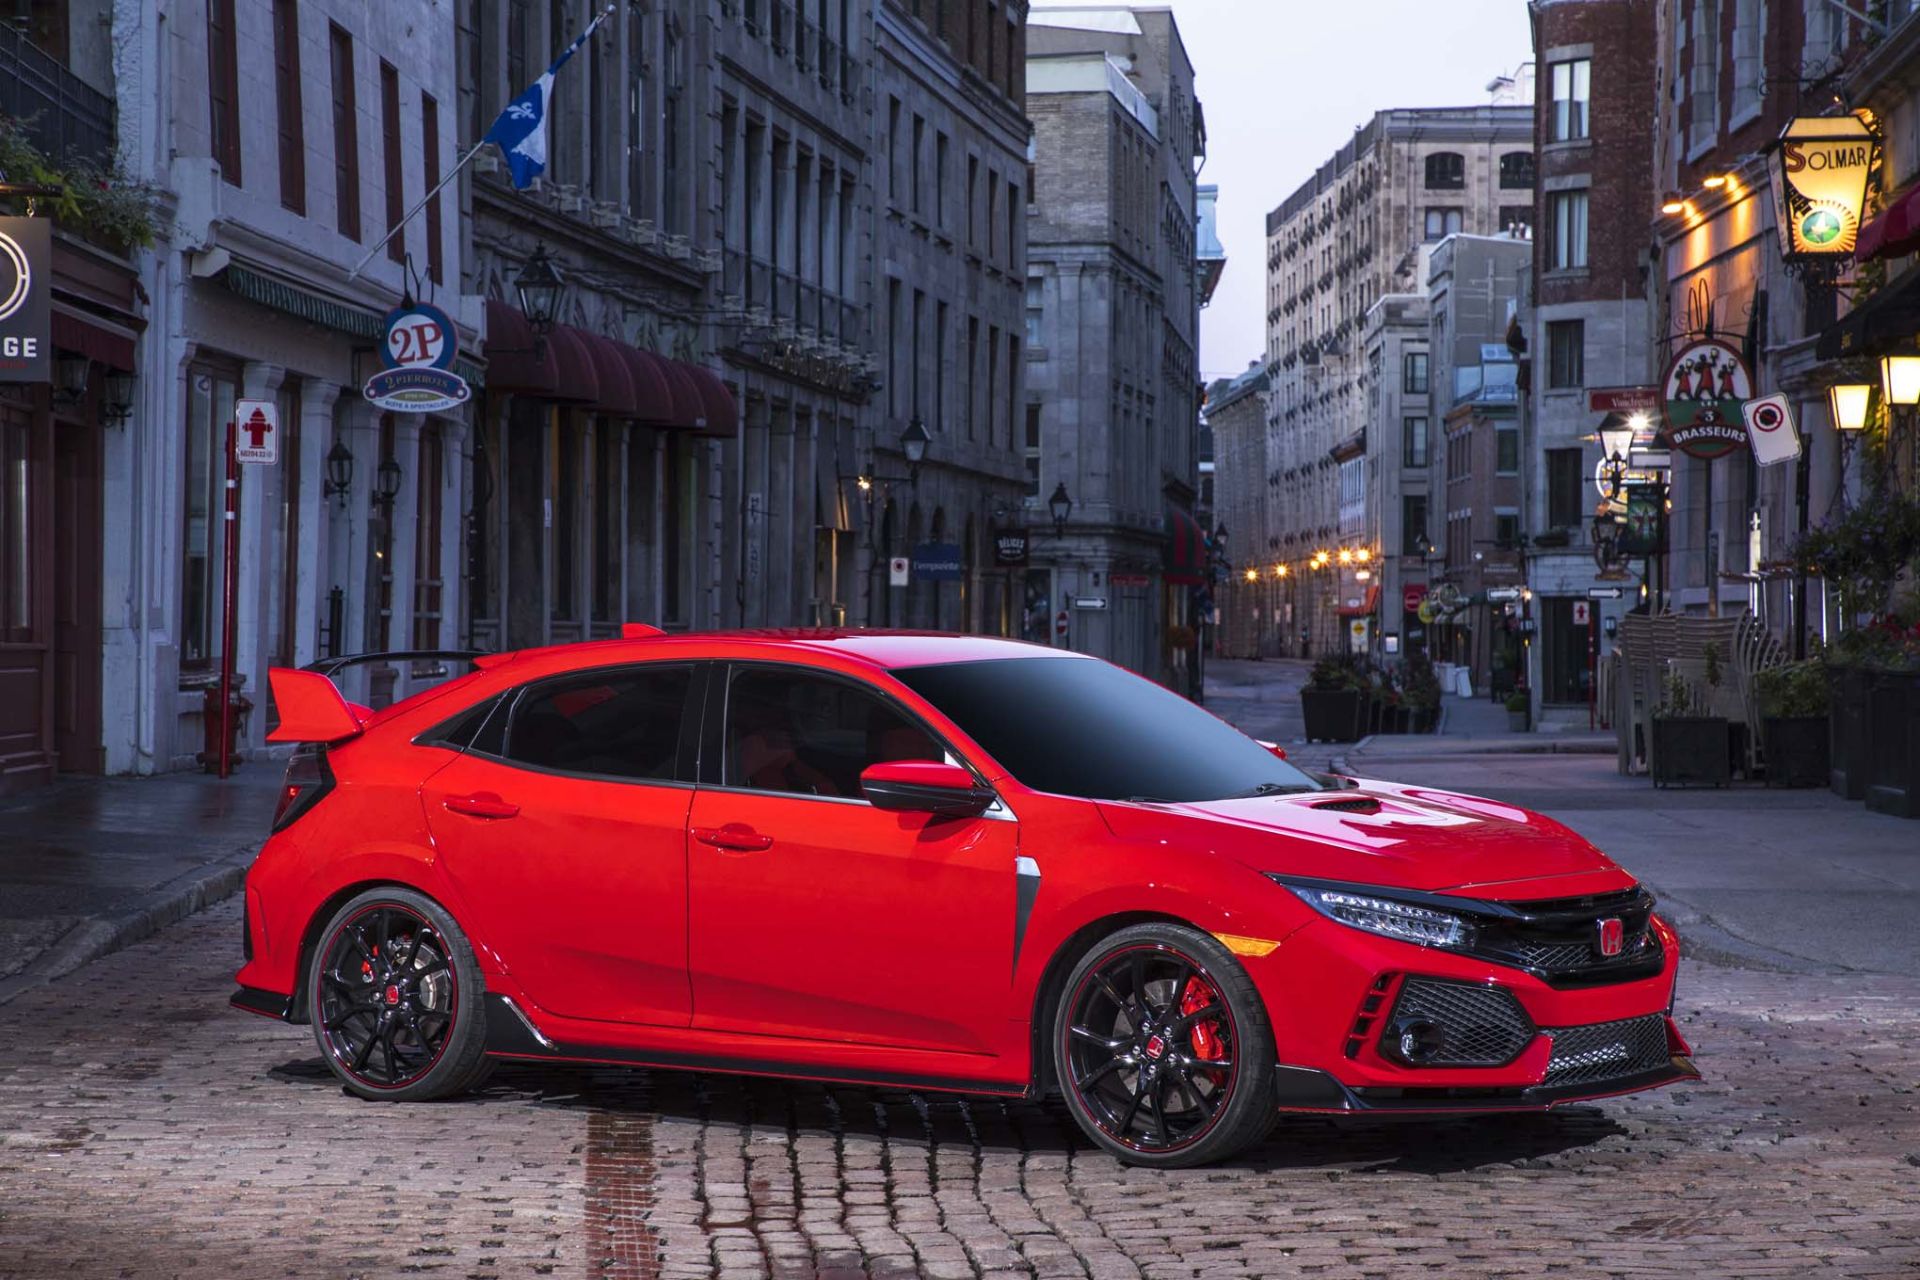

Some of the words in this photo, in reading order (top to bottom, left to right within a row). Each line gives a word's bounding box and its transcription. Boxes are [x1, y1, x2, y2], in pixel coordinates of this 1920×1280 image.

[1785, 142, 1867, 173] SOLMAR
[391, 323, 442, 364] 2P
[1705, 411, 1714, 422] 3
[1674, 426, 1746, 444] BRASSEURS
